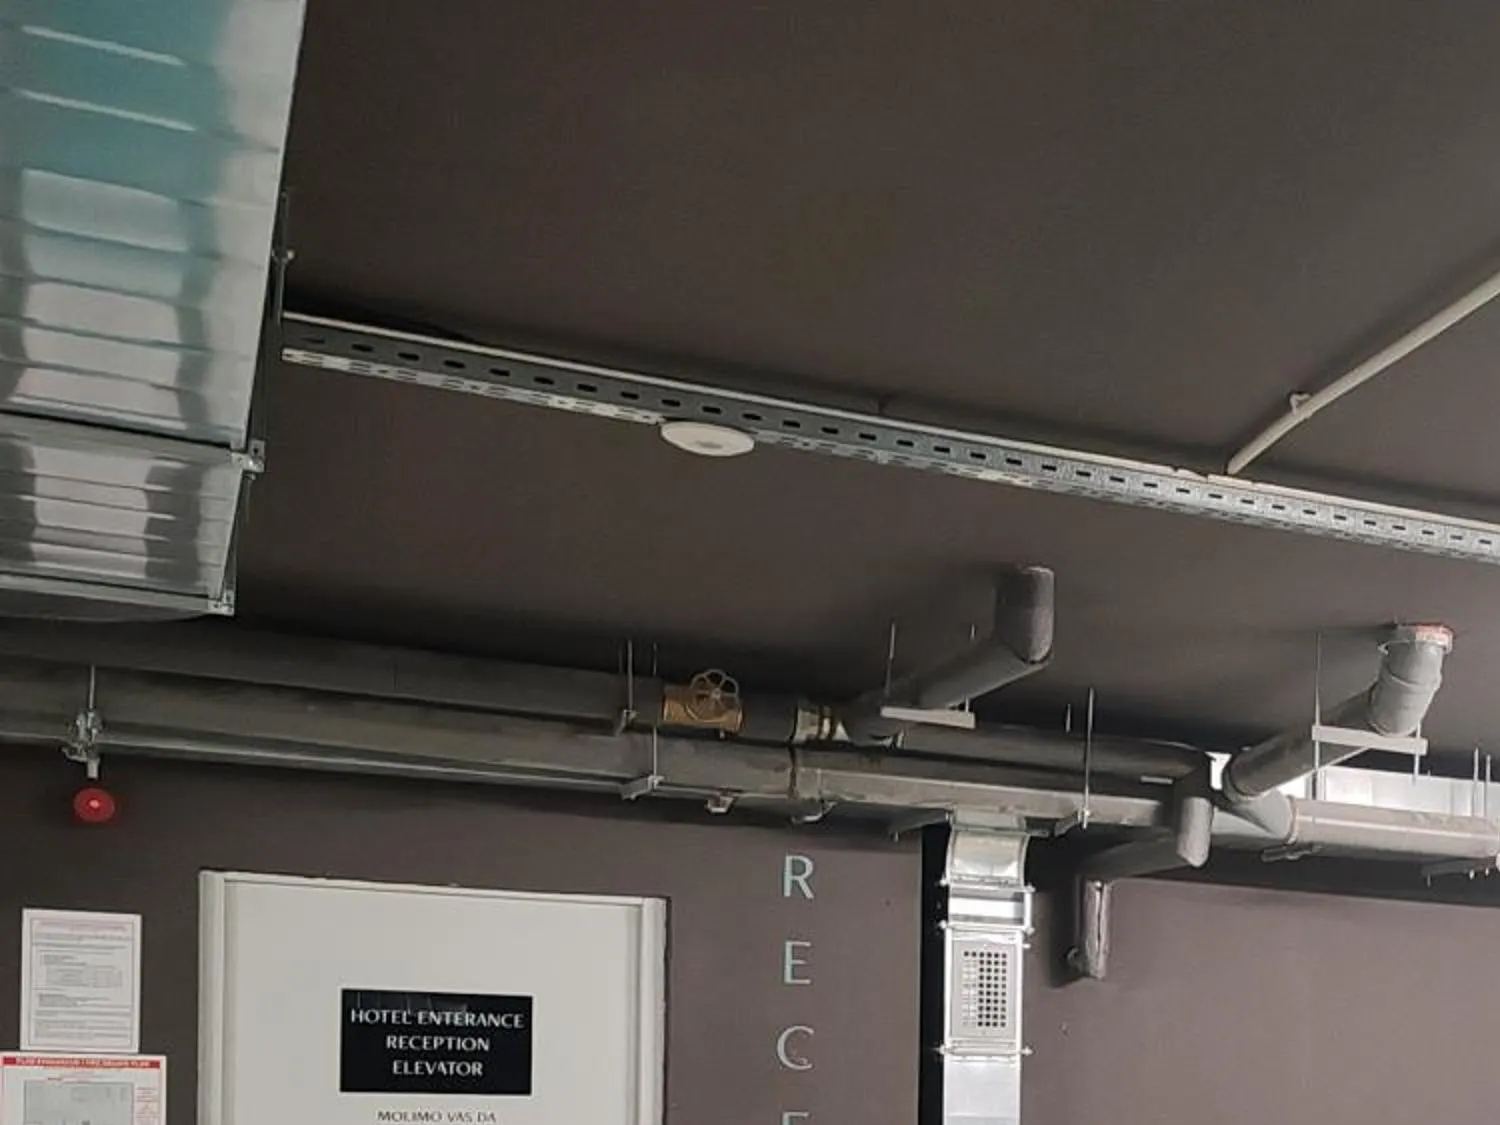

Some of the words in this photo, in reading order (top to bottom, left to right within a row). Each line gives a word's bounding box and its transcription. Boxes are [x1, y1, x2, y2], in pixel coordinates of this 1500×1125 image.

[351, 1008, 412, 1025] HOTEL
[417, 1010, 525, 1028] ENTERANCE
[386, 1035, 490, 1052] RECEPTION
[392, 1059, 483, 1077] ELEVATOR
[376, 1110, 442, 1123] MOLIMO
[447, 1111, 473, 1123] VAS
[477, 1111, 497, 1123] DA
